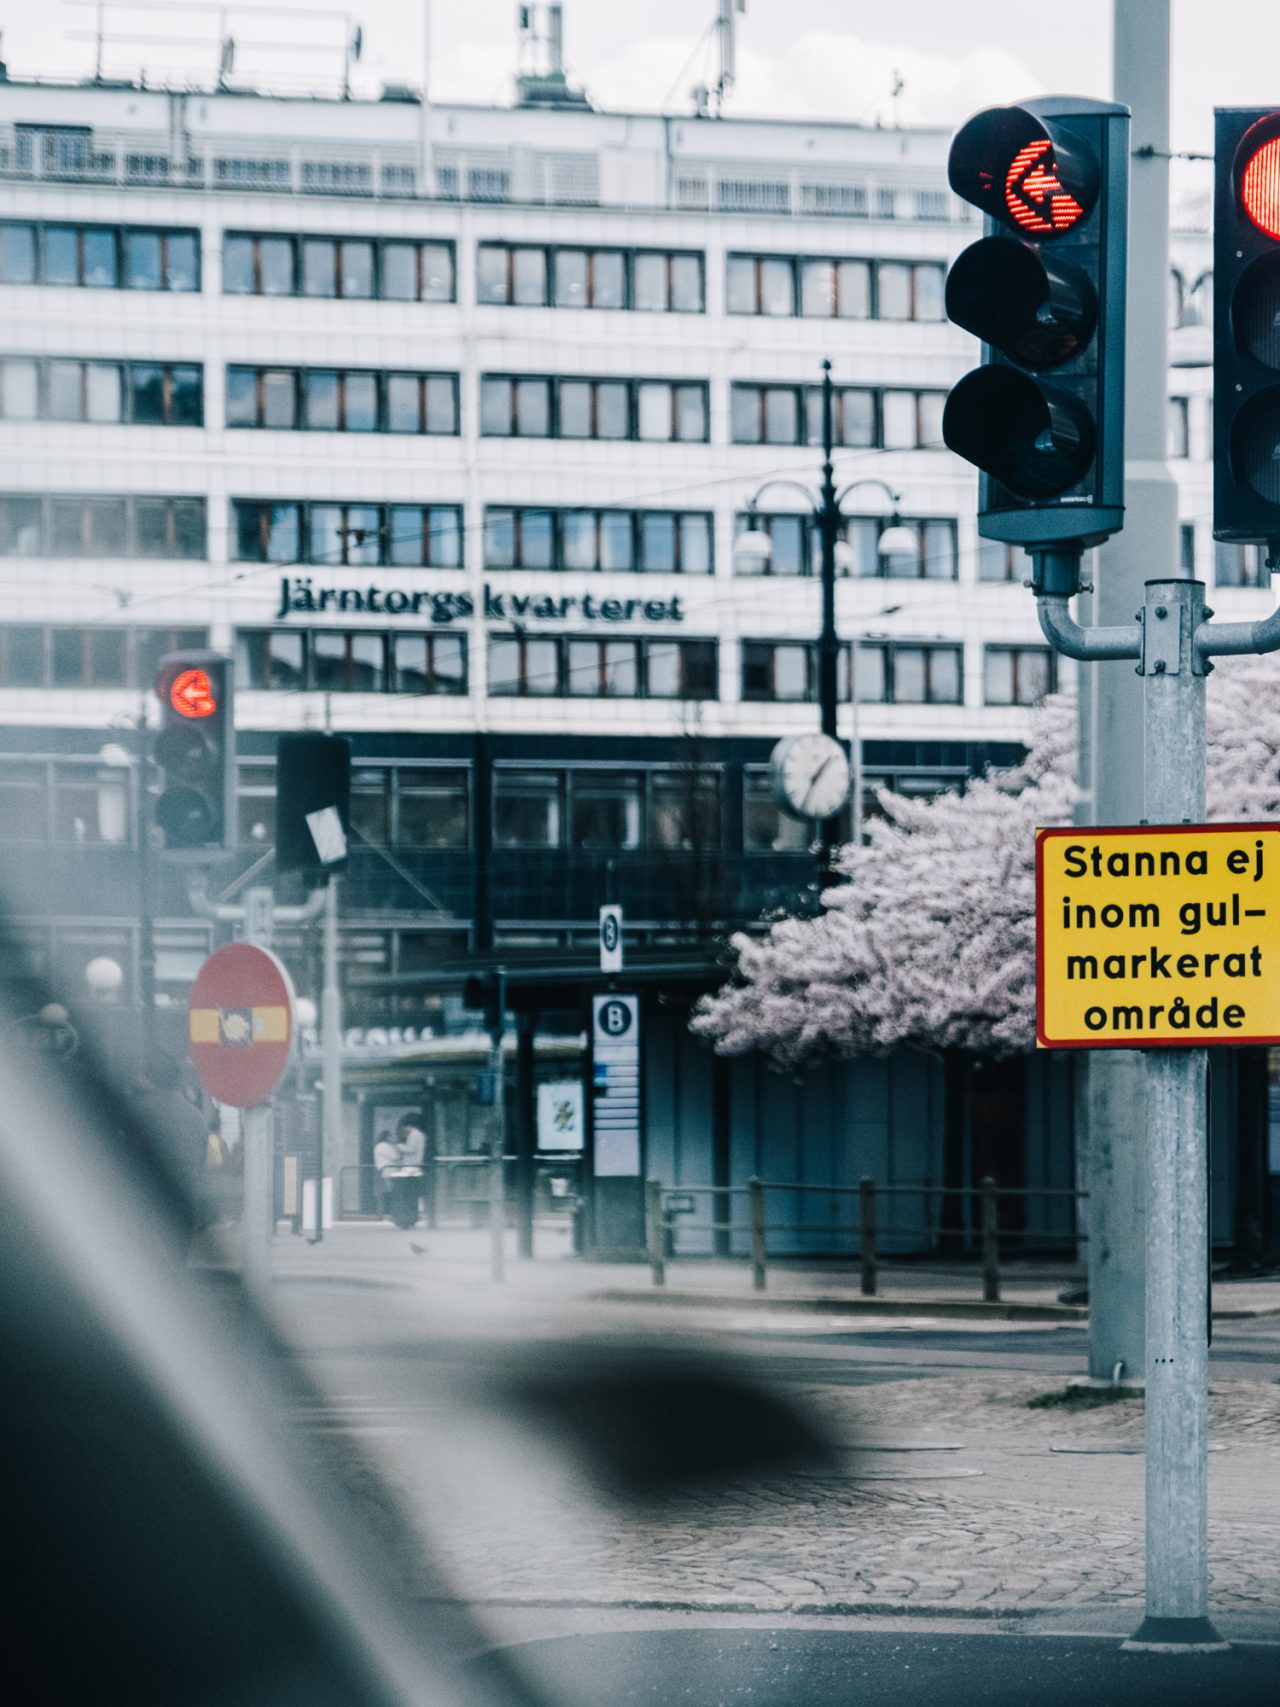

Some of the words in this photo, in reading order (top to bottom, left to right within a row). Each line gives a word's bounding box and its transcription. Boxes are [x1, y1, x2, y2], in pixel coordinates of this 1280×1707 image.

[1063, 845, 1208, 878] Stanna
[1226, 840, 1264, 882] ej
[1062, 895, 1160, 929] inom
[1178, 893, 1266, 935] gul-
[1066, 945, 1262, 980] markerat
[607, 1004, 623, 1032] B
[1083, 996, 1246, 1031] område
